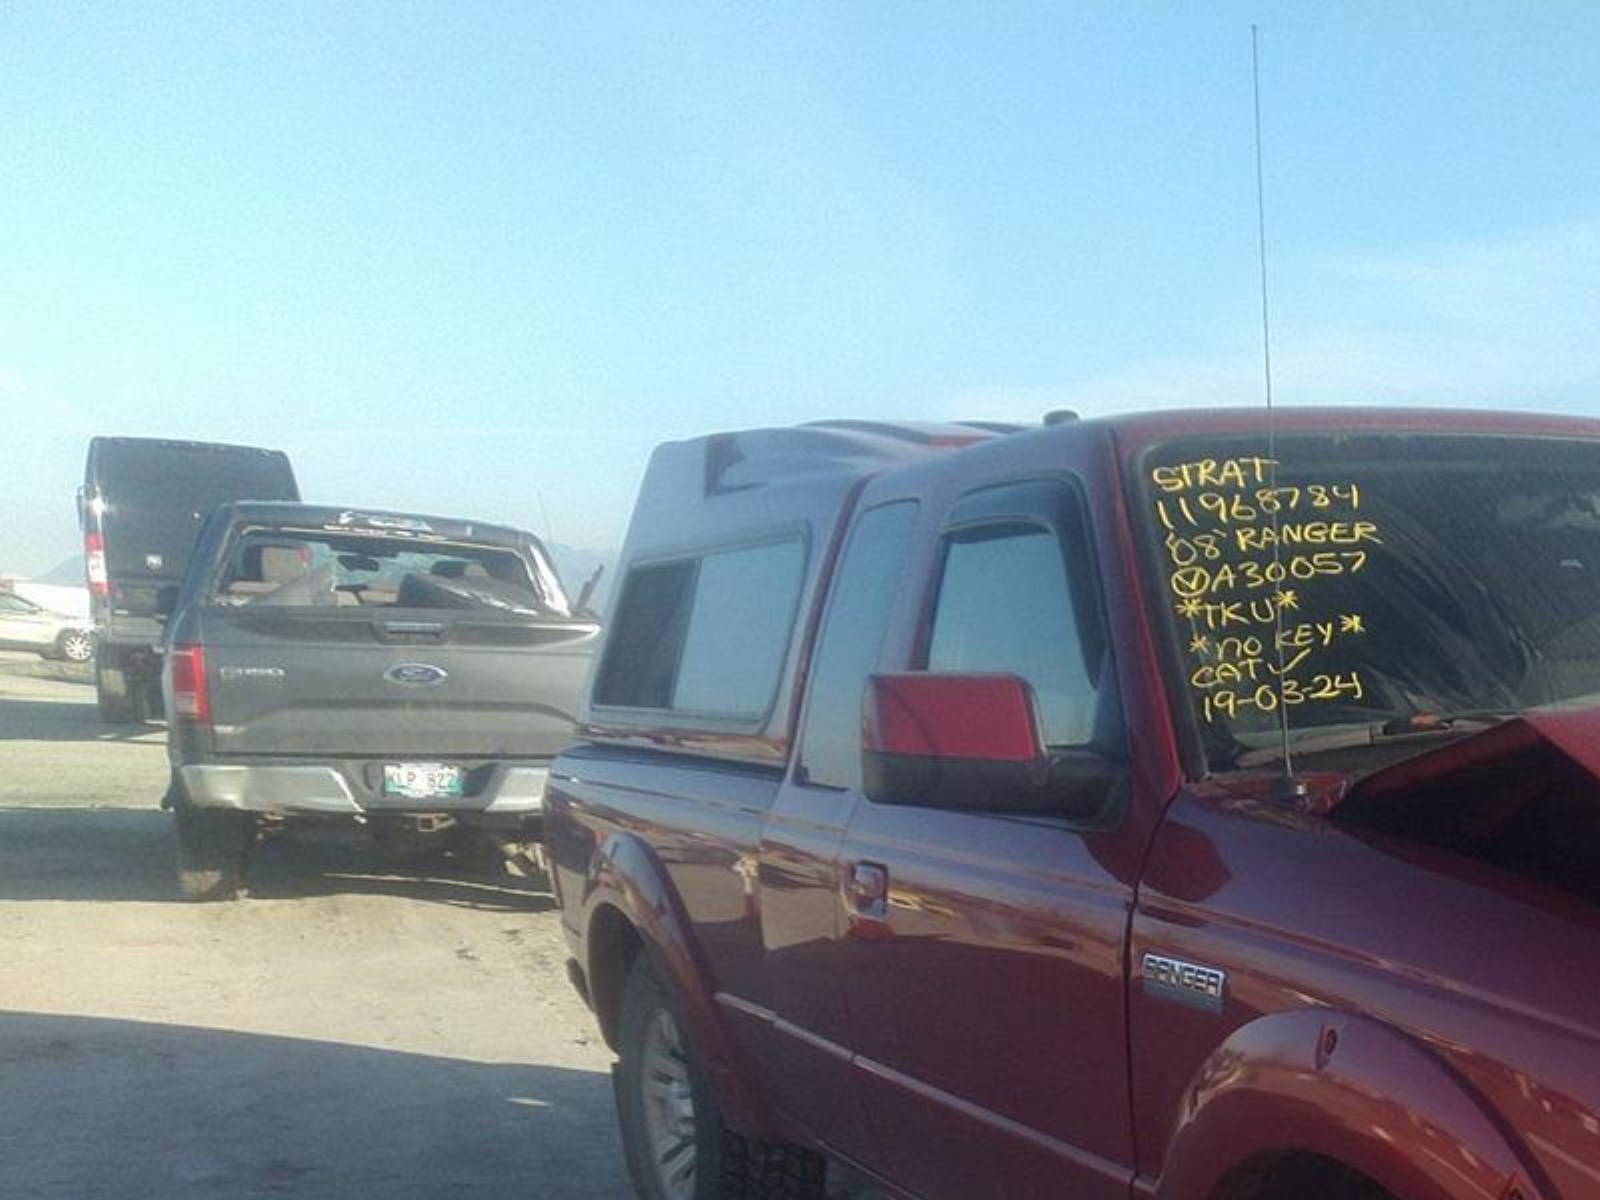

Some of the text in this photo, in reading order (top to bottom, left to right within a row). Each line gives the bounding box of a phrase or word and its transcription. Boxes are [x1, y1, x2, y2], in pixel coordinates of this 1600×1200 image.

[1152, 456, 1279, 491] STRAT
[1157, 484, 1359, 529] 11968784
[1236, 521, 1383, 552] RANGER
[1203, 672, 1363, 723] 19-03-24
